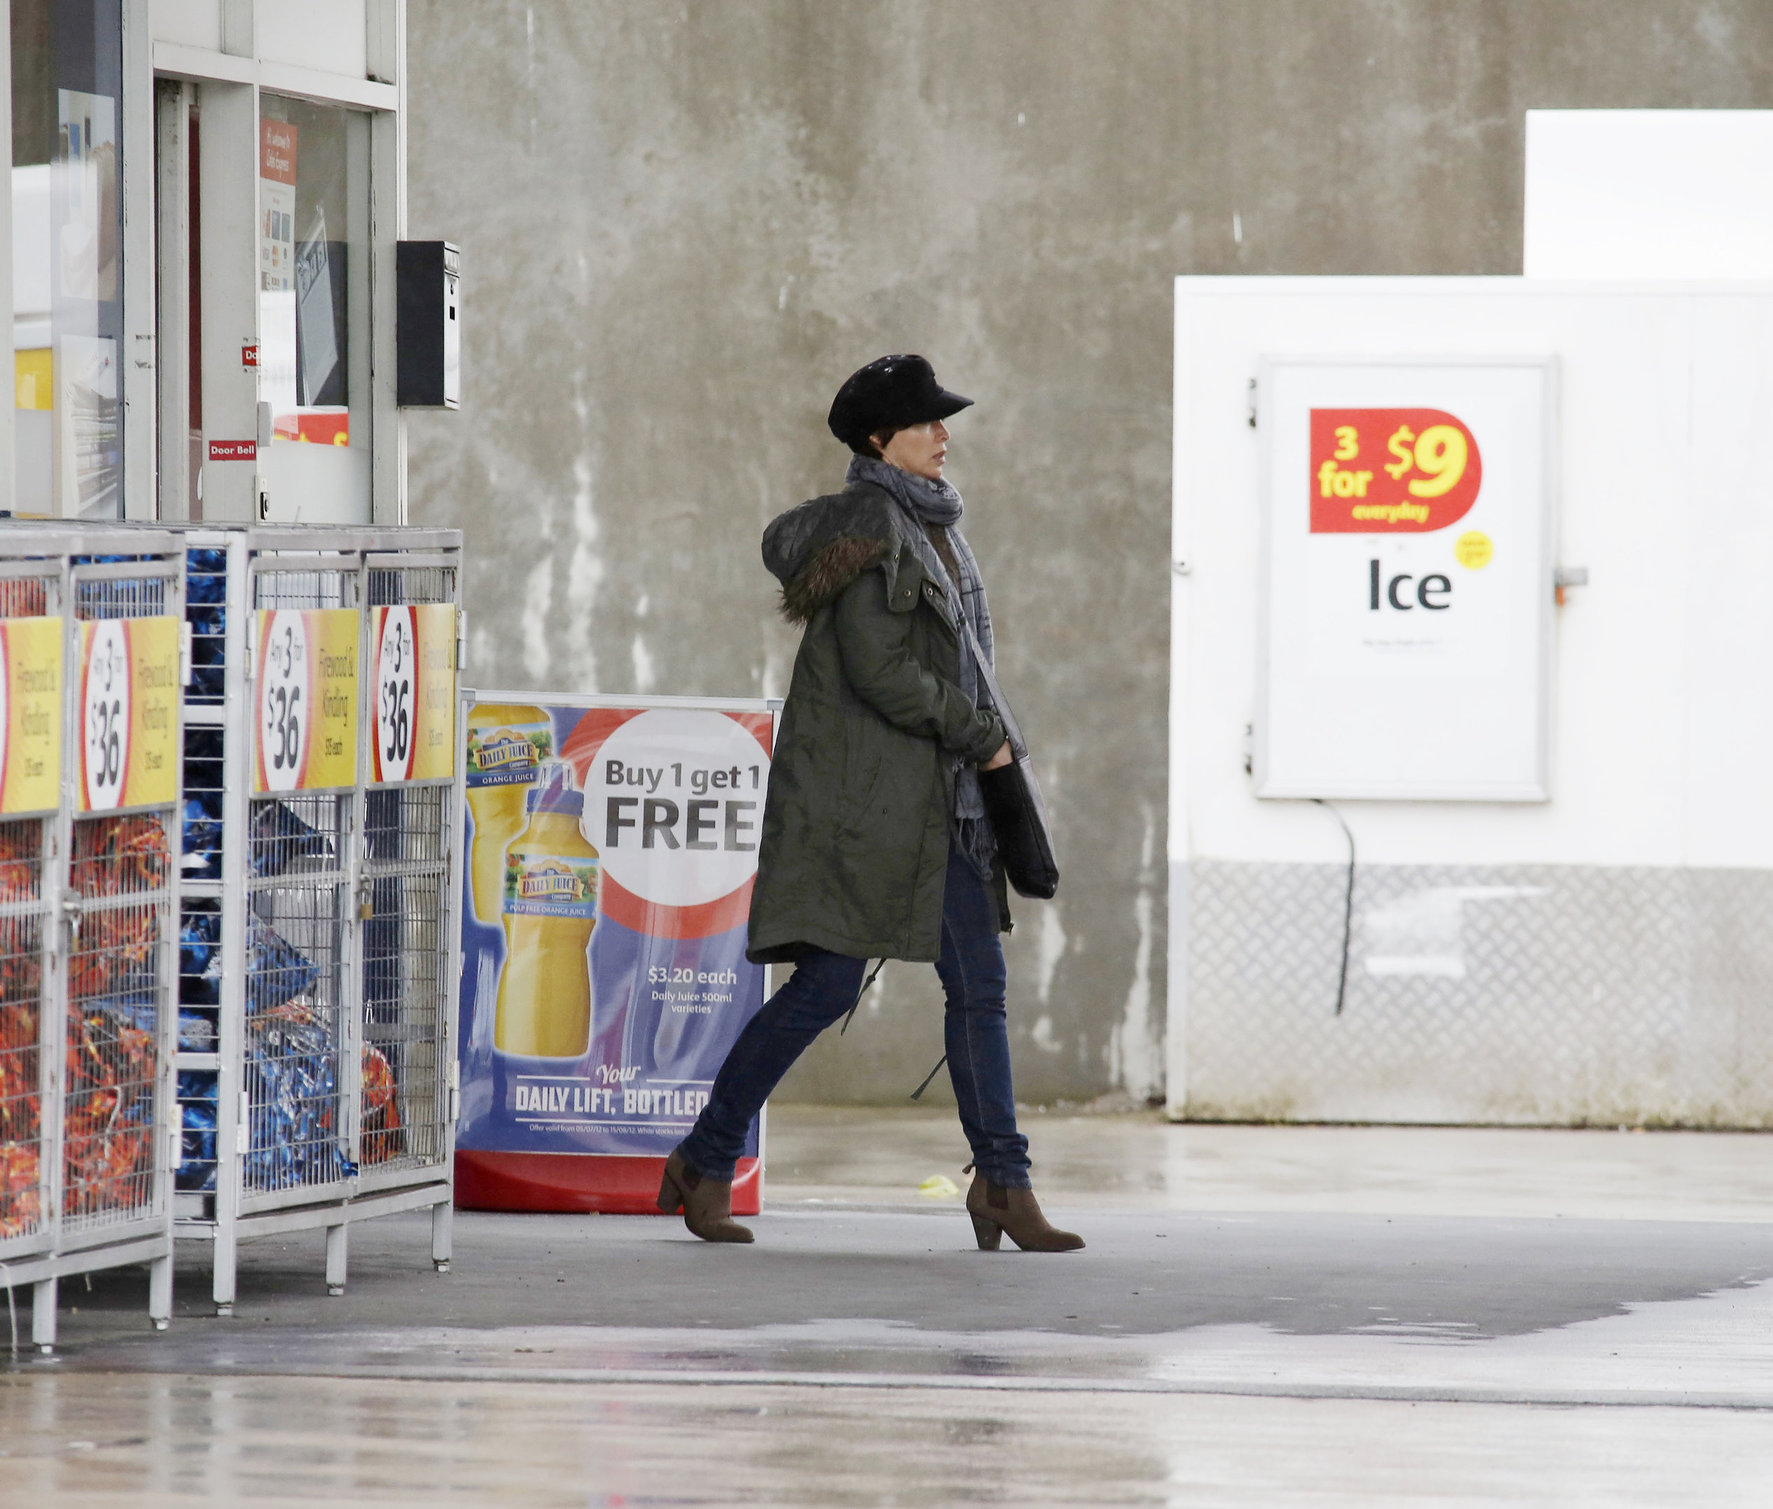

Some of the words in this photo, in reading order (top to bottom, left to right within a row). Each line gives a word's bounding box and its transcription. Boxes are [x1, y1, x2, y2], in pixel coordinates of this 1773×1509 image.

[211, 446, 235, 455] Door
[237, 444, 255, 455] Bell
[1334, 426, 1359, 460] 3
[1384, 424, 1468, 498] $9
[1318, 460, 1373, 498] for
[1352, 501, 1429, 523] everyday
[1370, 559, 1452, 610] Ice
[283, 626, 292, 679] 3
[394, 622, 401, 673] 3
[106, 638, 113, 692] 3
[267, 680, 300, 769] $36
[382, 675, 409, 762] $36
[91, 699, 120, 788] $36
[479, 748, 507, 767] DAILY
[508, 743, 533, 758] JUICE
[482, 774, 513, 785] ORANGE
[514, 773, 534, 783] JUICE
[606, 760, 664, 794] Buy
[670, 762, 682, 787] 1
[691, 765, 742, 796] get
[749, 765, 760, 789] 1
[605, 797, 757, 851] FREE
[523, 880, 551, 894] DAILY
[552, 877, 578, 891] JUICE
[509, 904, 525, 913] PULP
[525, 905, 539, 914] FREE
[541, 906, 569, 915] ORANGE
[569, 907, 586, 916] JUICE
[648, 965, 694, 985] $3.20
[697, 968, 737, 985] each
[651, 990, 676, 1003] Daily
[677, 991, 700, 1002] Juice
[702, 992, 732, 1003] 500ml
[671, 1004, 712, 1014] varieties
[596, 1063, 642, 1086] Your
[515, 1086, 570, 1112] DAILY
[574, 1087, 616, 1116] LIFT,
[624, 1089, 709, 1116] BOTTLED
[529, 1124, 544, 1132] Offer
[545, 1124, 560, 1132] valid
[560, 1124, 575, 1133] from
[655, 1128, 673, 1136] stocks
